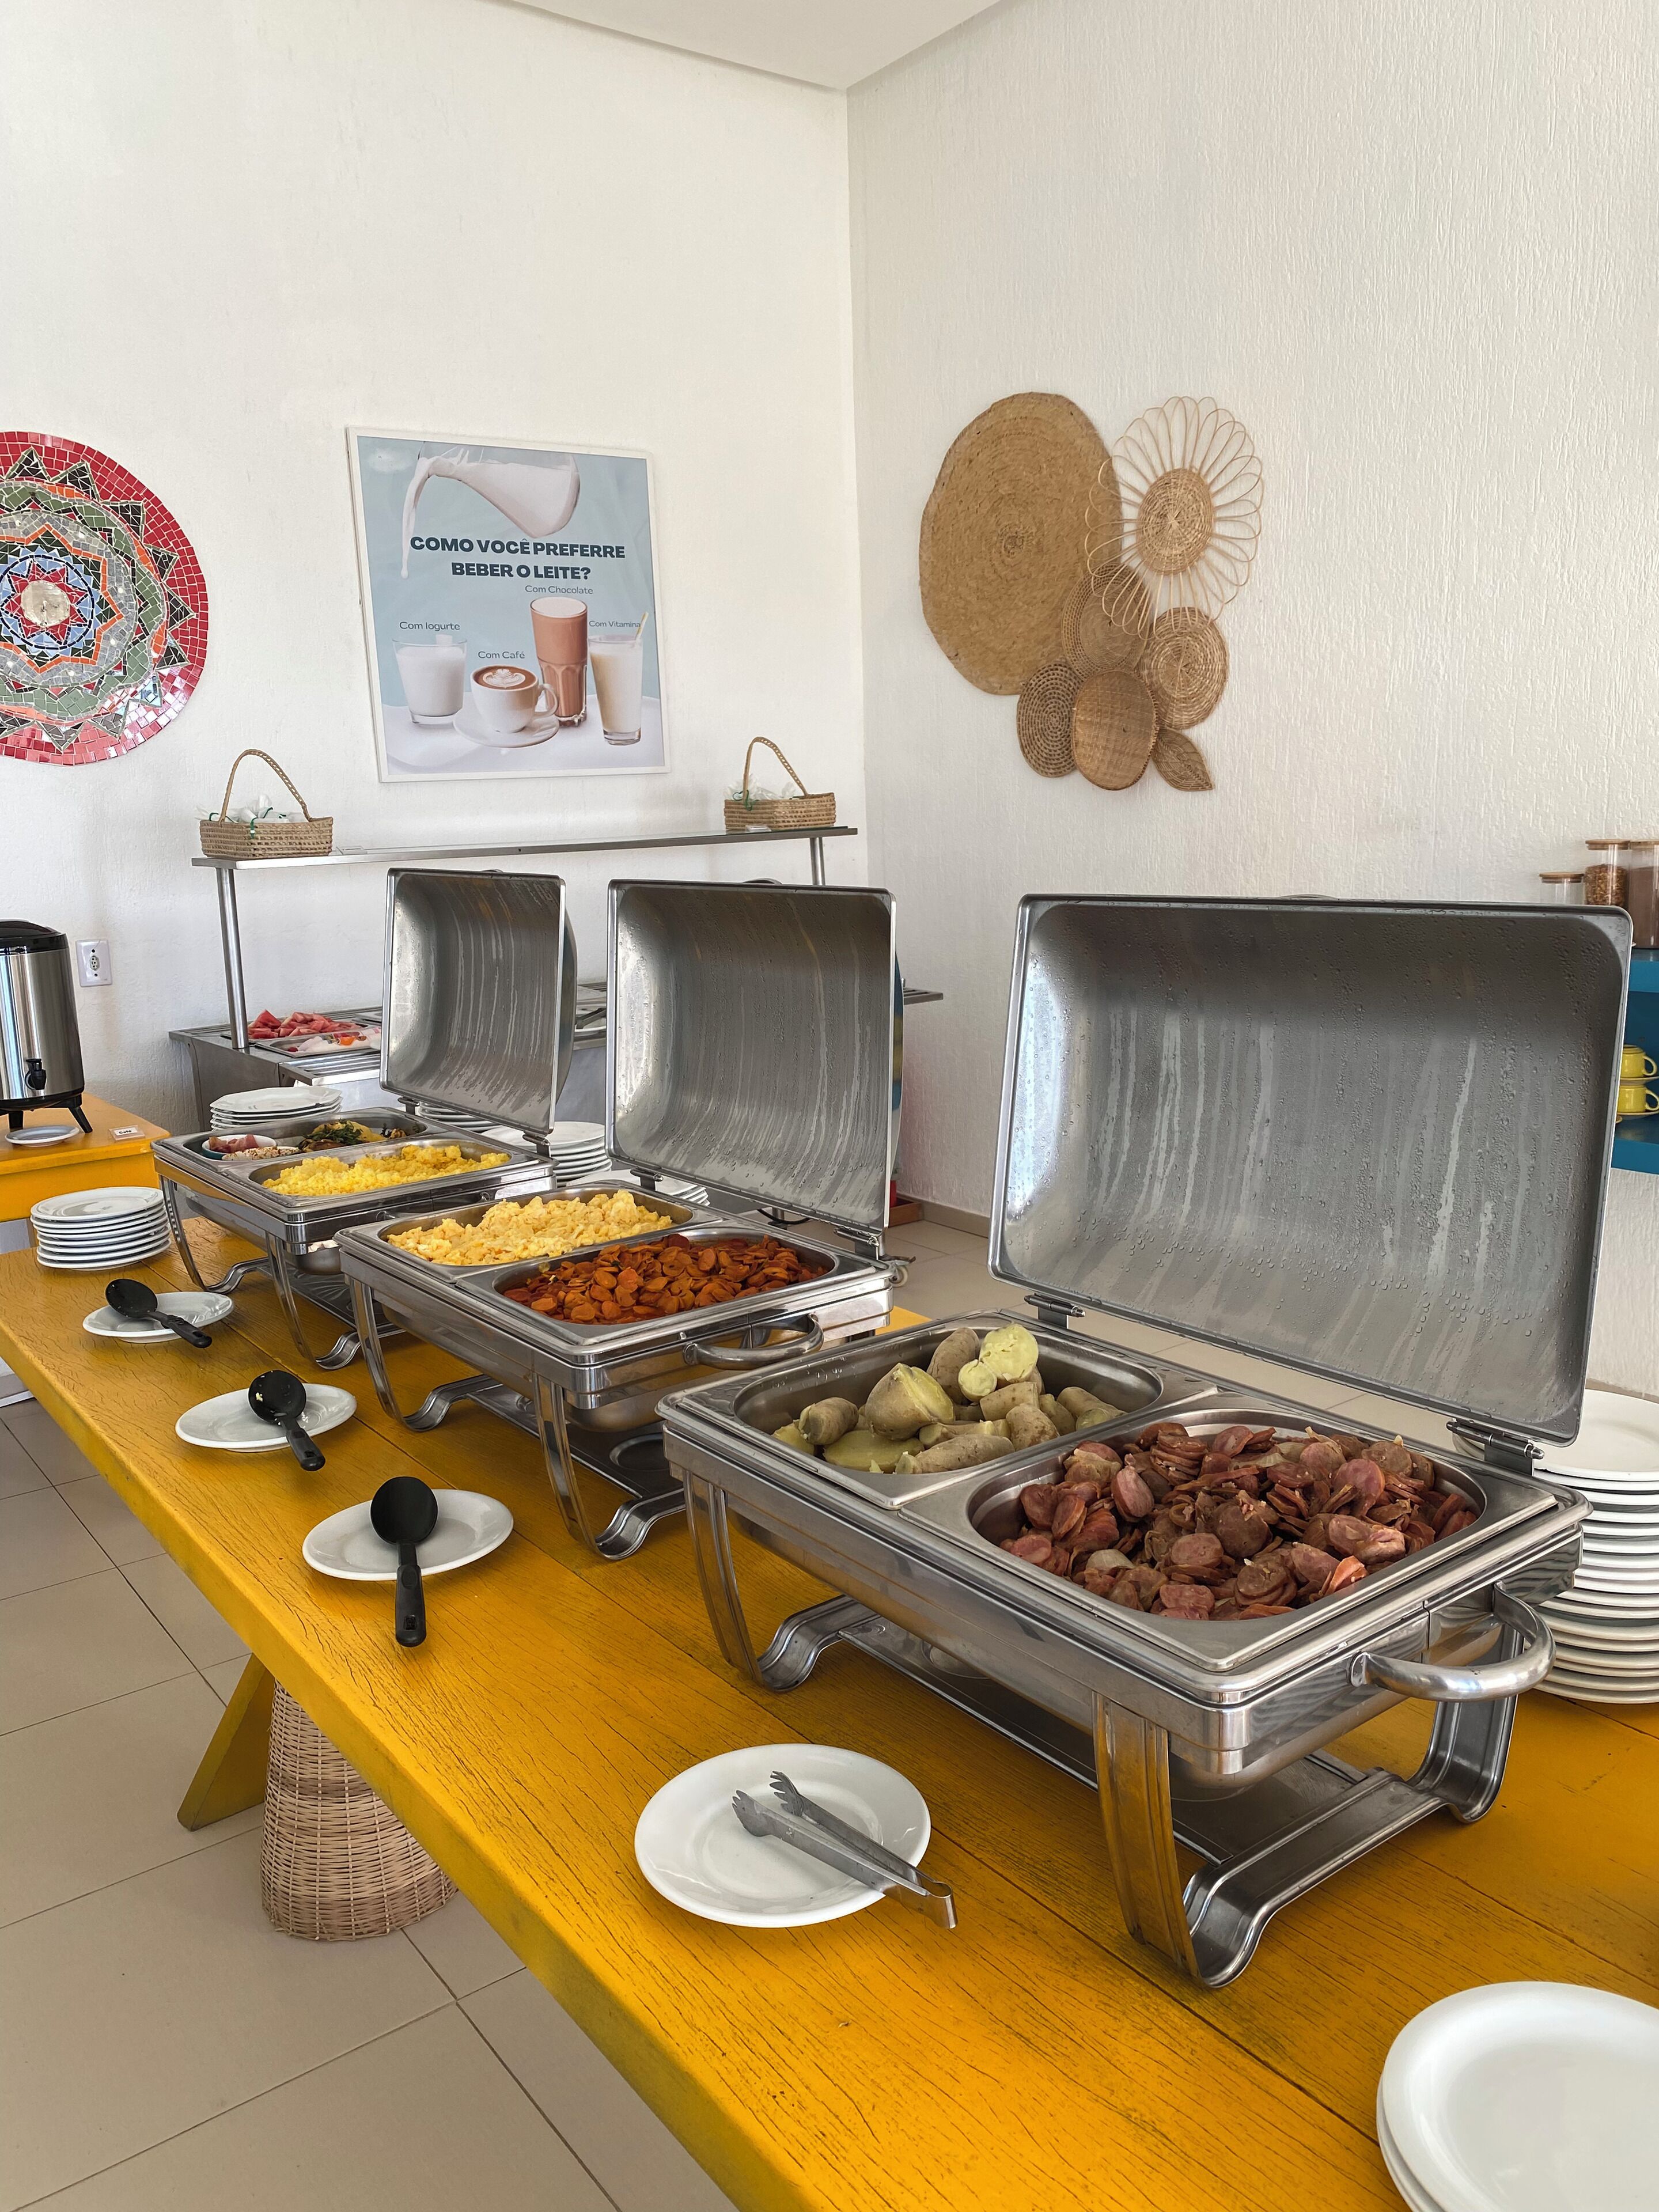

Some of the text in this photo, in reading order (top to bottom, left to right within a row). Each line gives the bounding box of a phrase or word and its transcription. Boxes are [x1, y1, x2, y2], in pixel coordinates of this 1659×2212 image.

[410, 536, 625, 558] COMO VOCÊ PREFERRE
[451, 562, 591, 579] BEBER O LEITE?
[548, 586, 593, 594] Chocolate
[399, 622, 460, 631] Com Iogurte
[502, 651, 525, 659] Café
